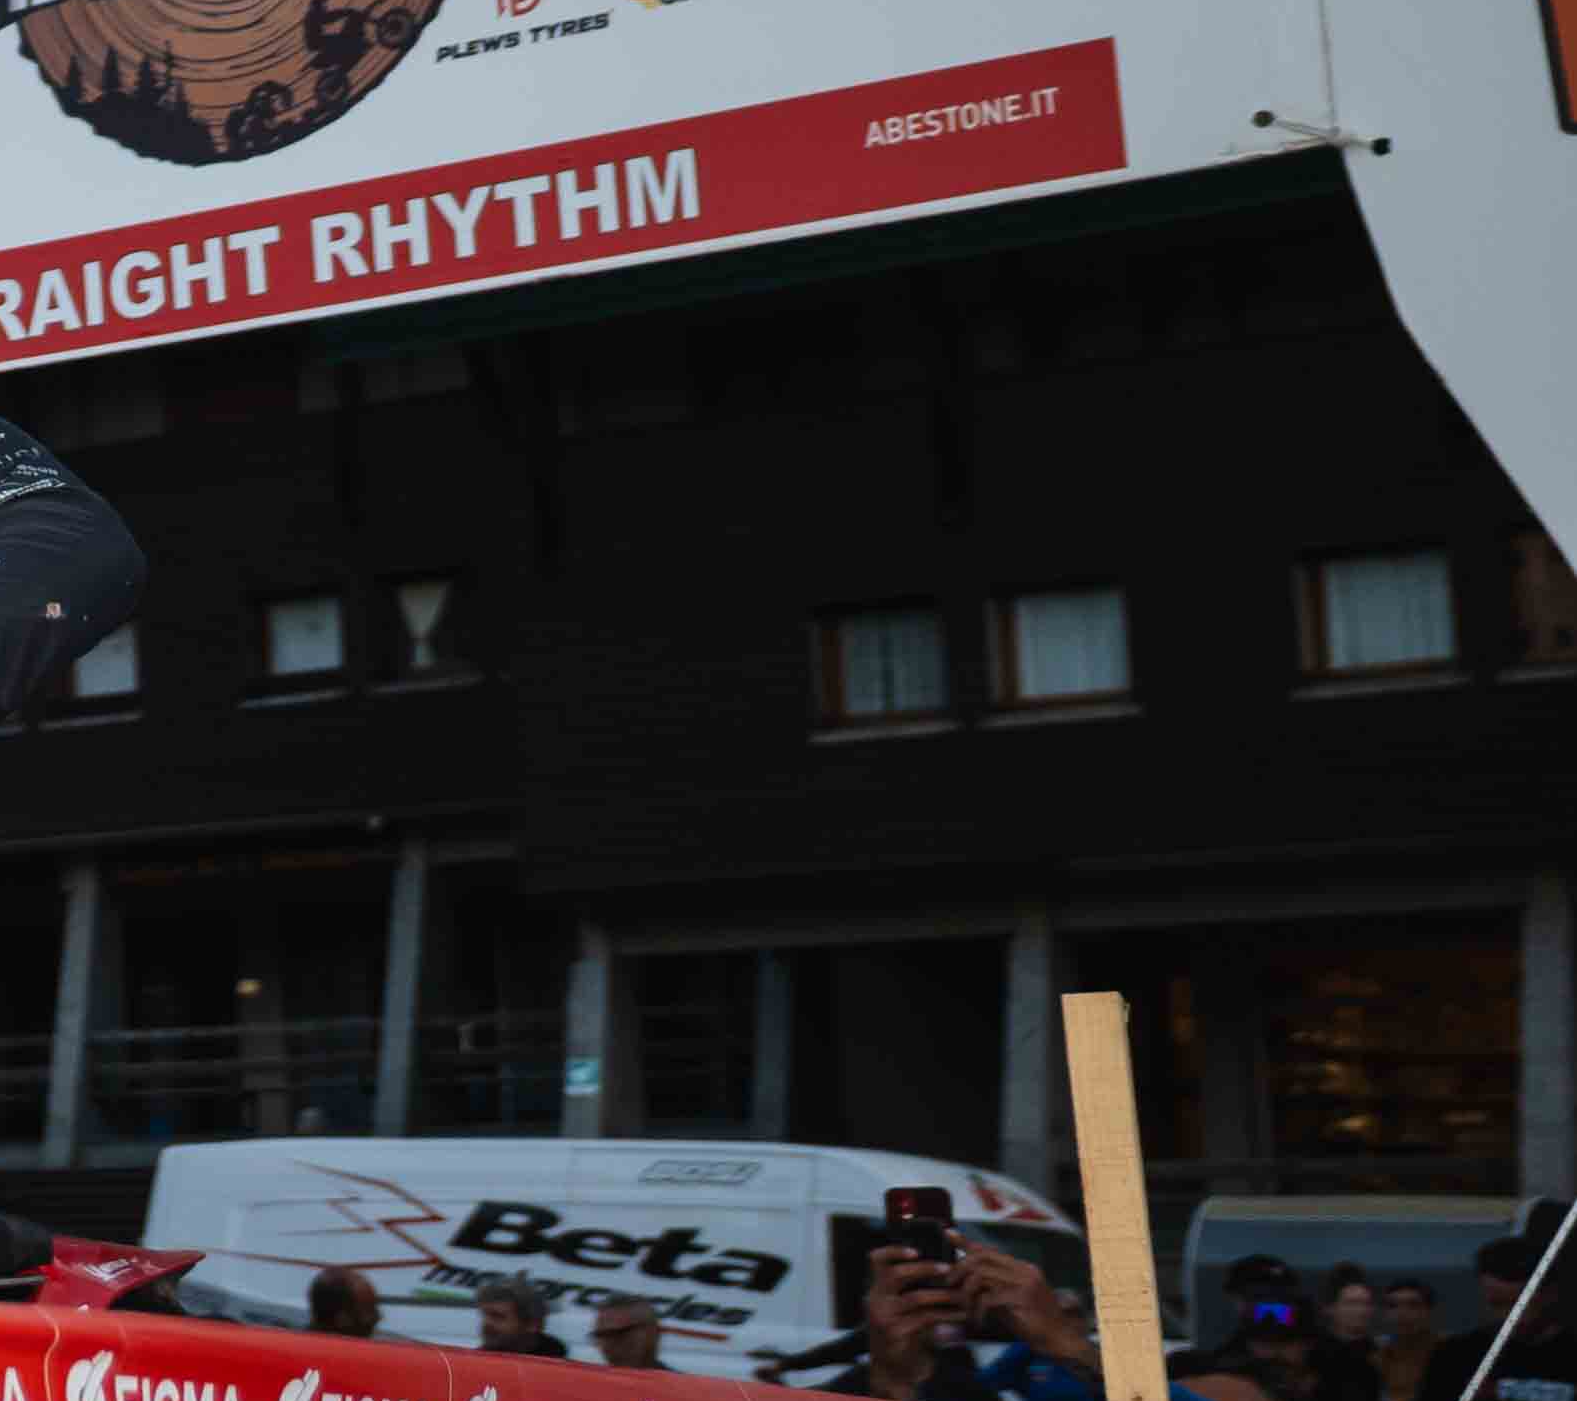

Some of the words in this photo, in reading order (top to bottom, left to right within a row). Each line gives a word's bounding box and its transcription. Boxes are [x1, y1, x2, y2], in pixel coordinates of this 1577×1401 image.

[436, 30, 521, 64] PLEWS
[530, 11, 611, 47] TYRES
[864, 87, 1060, 150] ABESTONE.IT
[312, 148, 701, 285] RHYTHM
[450, 1201, 792, 1296] Beta
